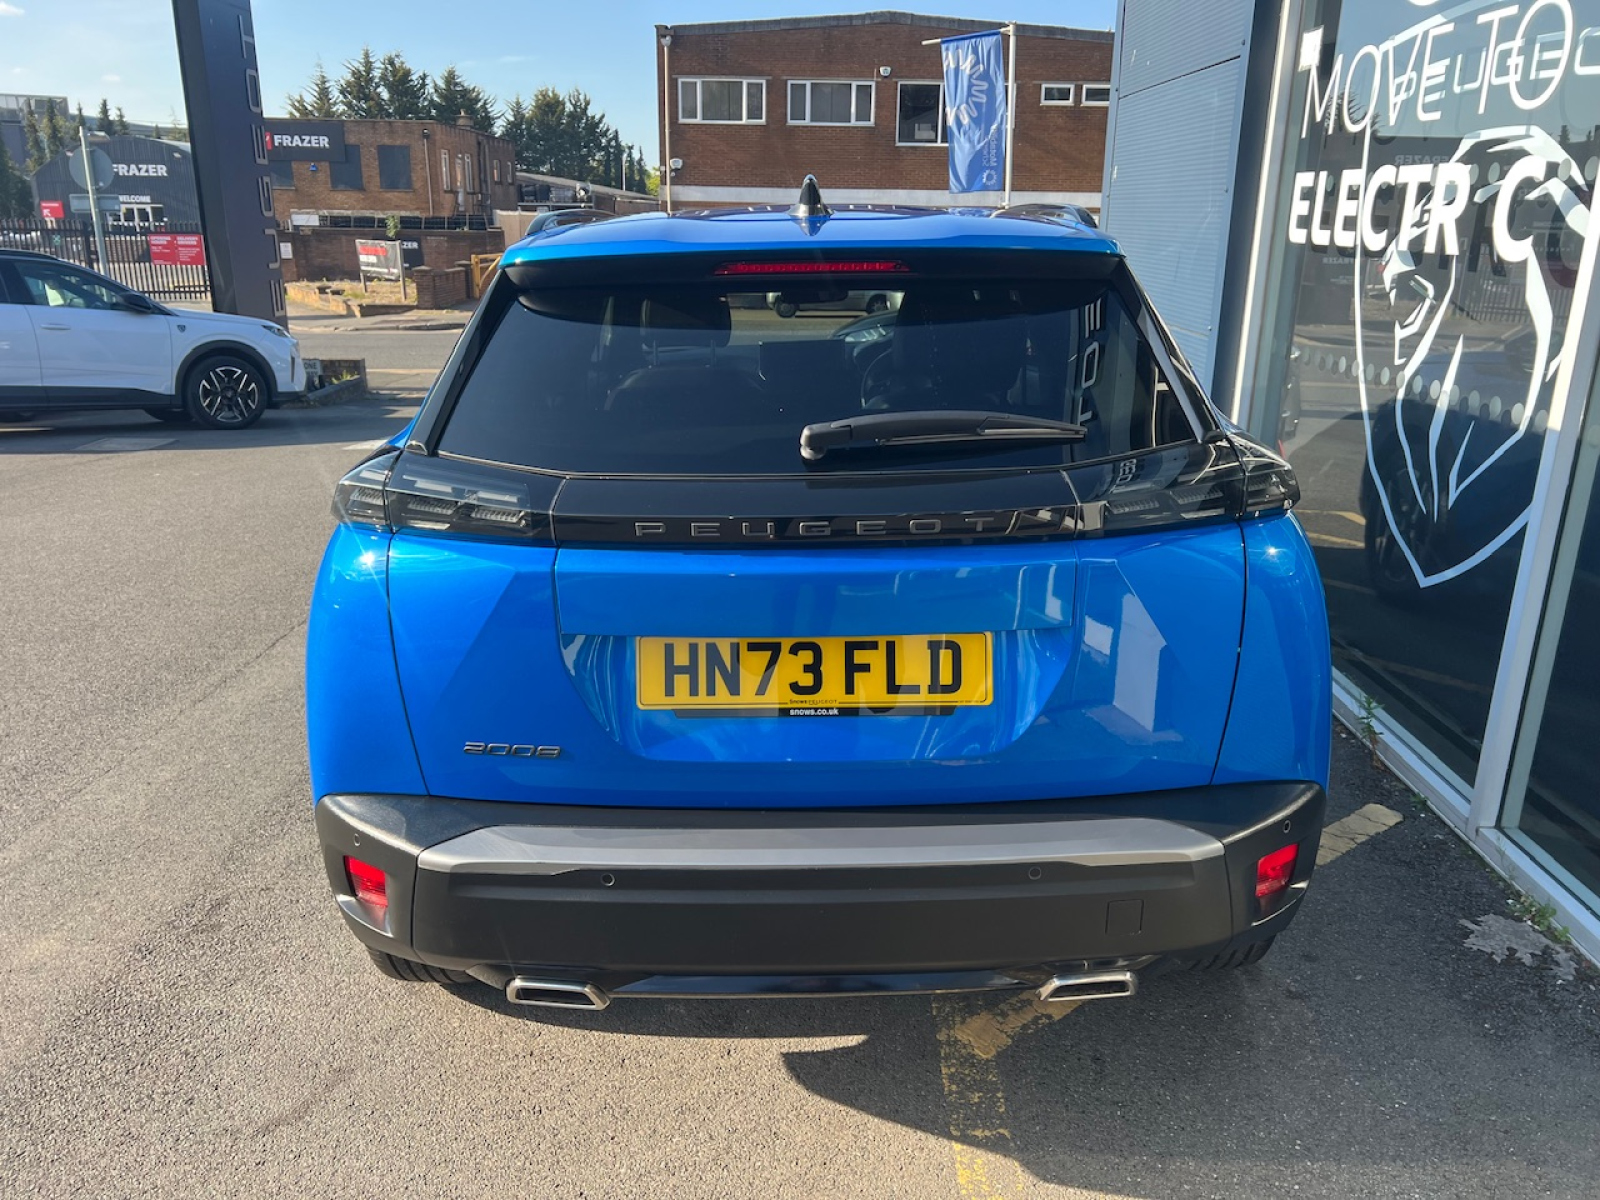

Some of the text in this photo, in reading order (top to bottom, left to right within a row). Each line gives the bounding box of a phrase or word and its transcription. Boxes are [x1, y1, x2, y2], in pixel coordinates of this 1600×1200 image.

[1301, 0, 1573, 139] MOVE TO
[1393, 27, 1600, 106] PEUGEO
[273, 134, 330, 148] FRAZER
[112, 163, 168, 176] FRAZER
[238, 15, 286, 317] EUGEOT
[1288, 155, 1547, 263] ELECTRC
[635, 516, 994, 538] PEUGEOT
[664, 640, 962, 697] HN73 FLD
[789, 708, 839, 716] snows.co.uk
[463, 741, 560, 758] 2008
